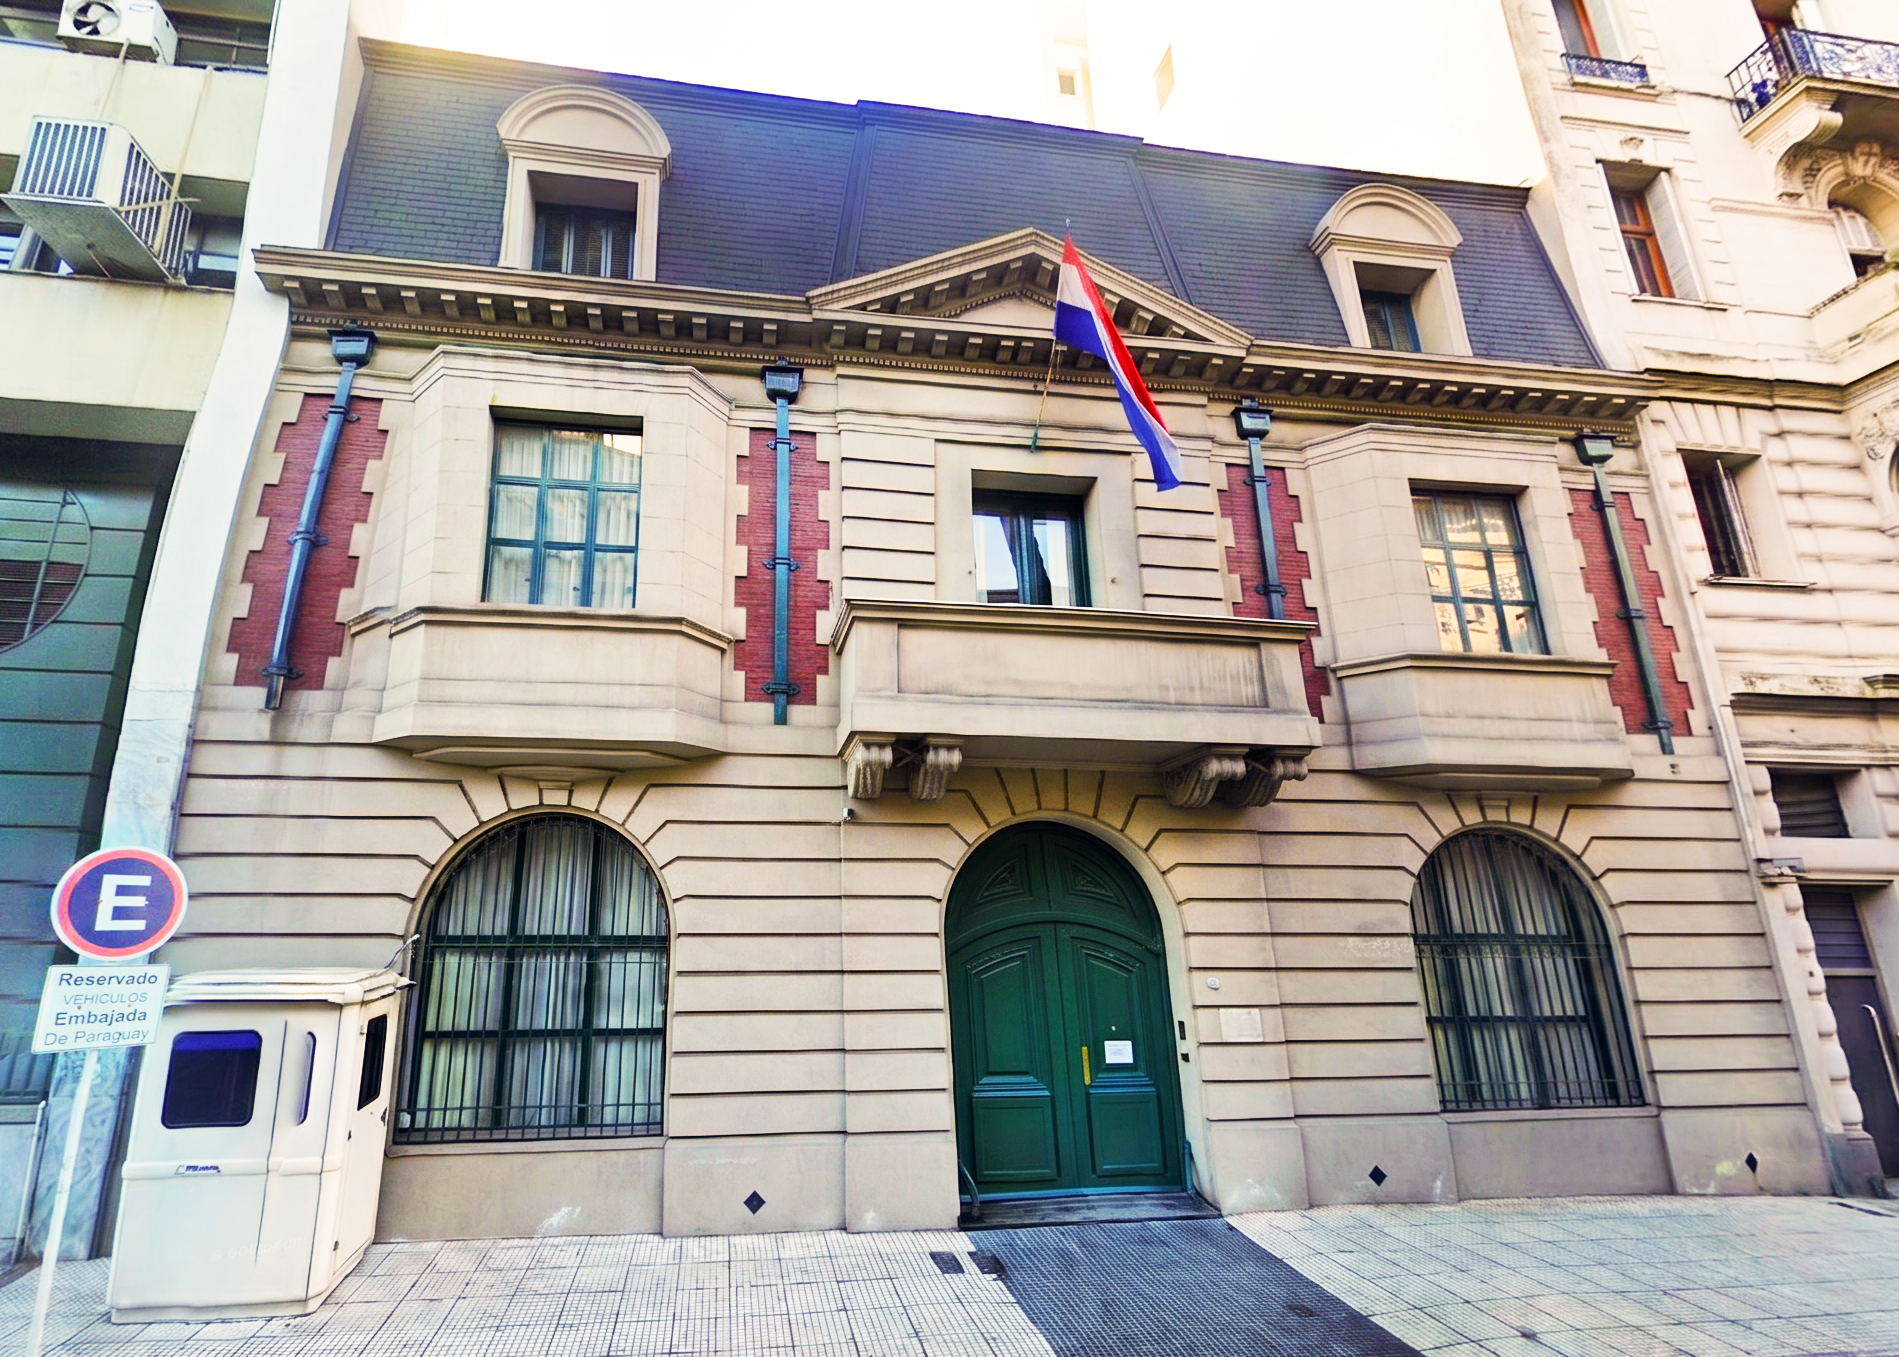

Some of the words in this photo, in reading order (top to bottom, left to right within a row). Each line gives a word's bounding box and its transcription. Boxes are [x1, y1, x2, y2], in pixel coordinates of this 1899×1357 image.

[94, 874, 152, 931] E
[58, 972, 158, 987] Reservado
[63, 992, 148, 1005] VEHICULOS
[54, 1009, 147, 1026] Embajada
[44, 1032, 68, 1046] De
[73, 1029, 150, 1044] Paraguay
